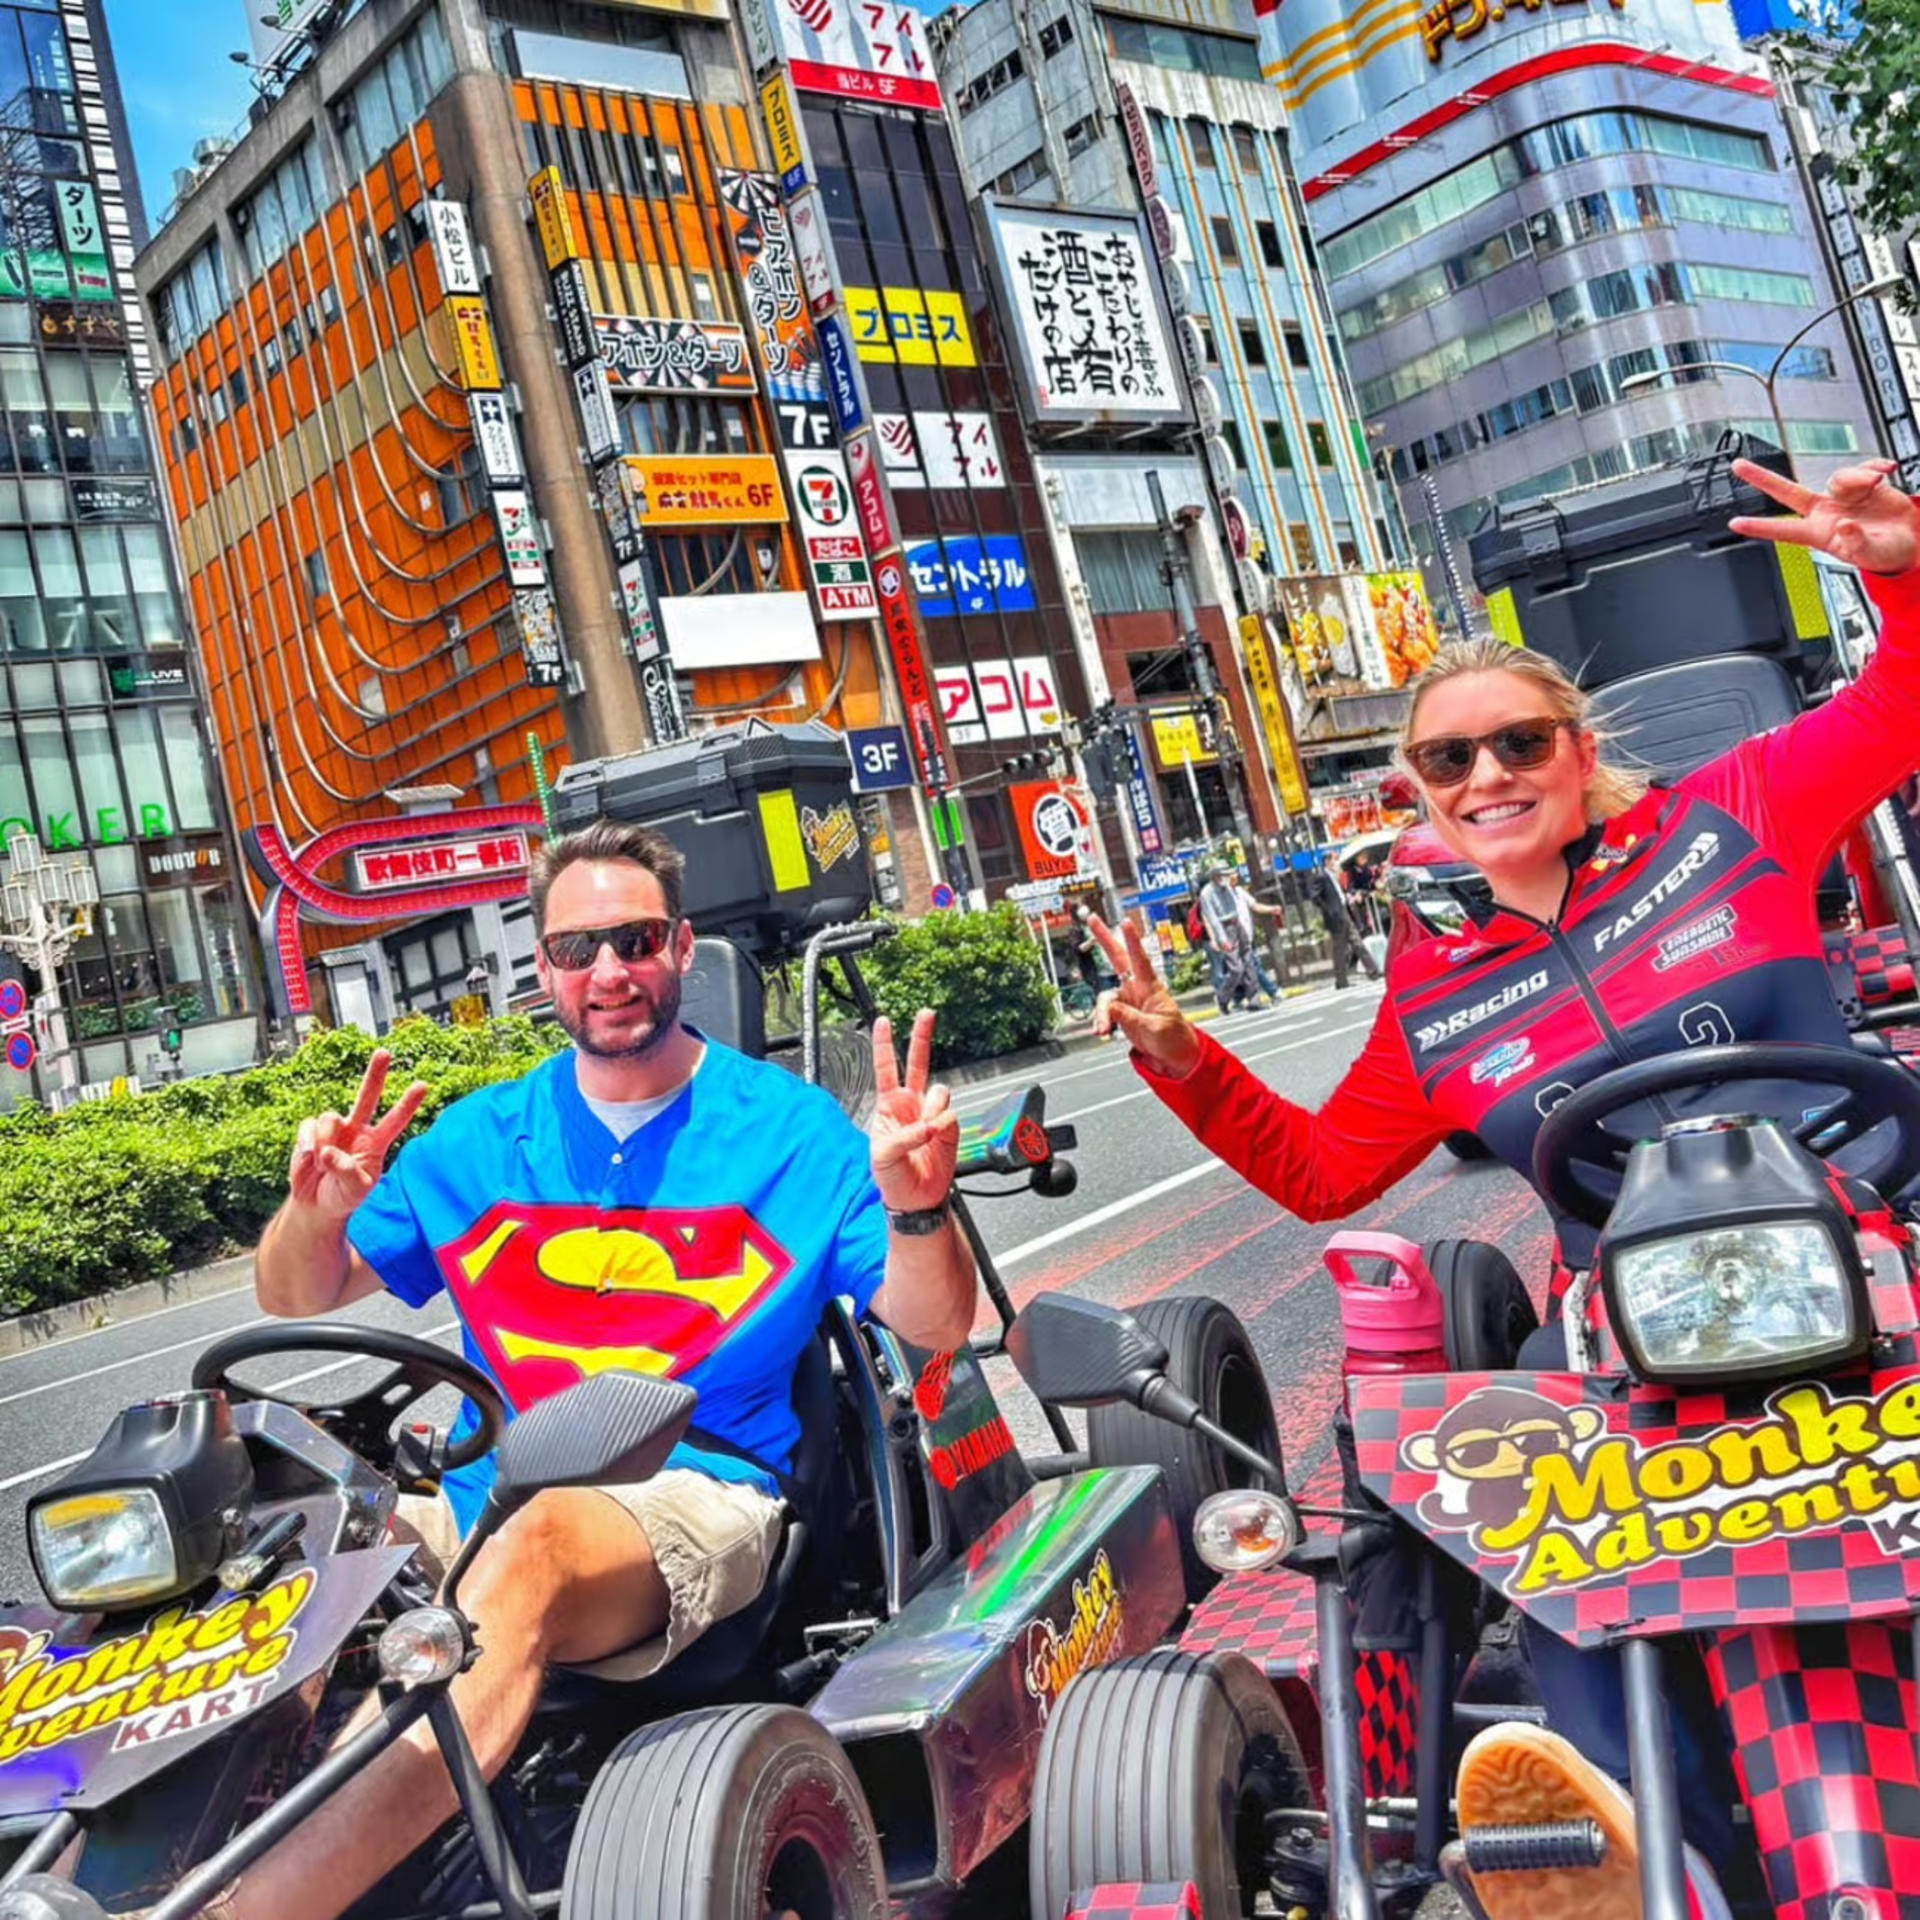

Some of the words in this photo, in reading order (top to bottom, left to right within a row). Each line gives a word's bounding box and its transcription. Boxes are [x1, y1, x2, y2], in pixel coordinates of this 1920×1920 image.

[64, 186, 94, 246] ダーツ
[440, 205, 471, 286] 小松ビル
[854, 307, 963, 344] プロミス
[1018, 250, 1077, 395] だけの店
[1090, 250, 1140, 395] こだわりの
[825, 331, 856, 417] セントラル
[779, 405, 831, 446] 7F
[747, 484, 774, 507] 6F
[827, 587, 872, 607] ATM
[908, 556, 1028, 594] セントラル
[537, 663, 562, 683] 7F
[935, 670, 1054, 720] アコム
[861, 742, 899, 773] 3F
[150, 848, 221, 874] DOUTOR
[364, 838, 521, 884] 歌舞伎町一番街
[1593, 856, 1704, 953] FASTER
[1447, 969, 1550, 1031] Racing
[948, 1414, 1015, 1477] YAMAHA
[116, 1679, 273, 1748] KART
